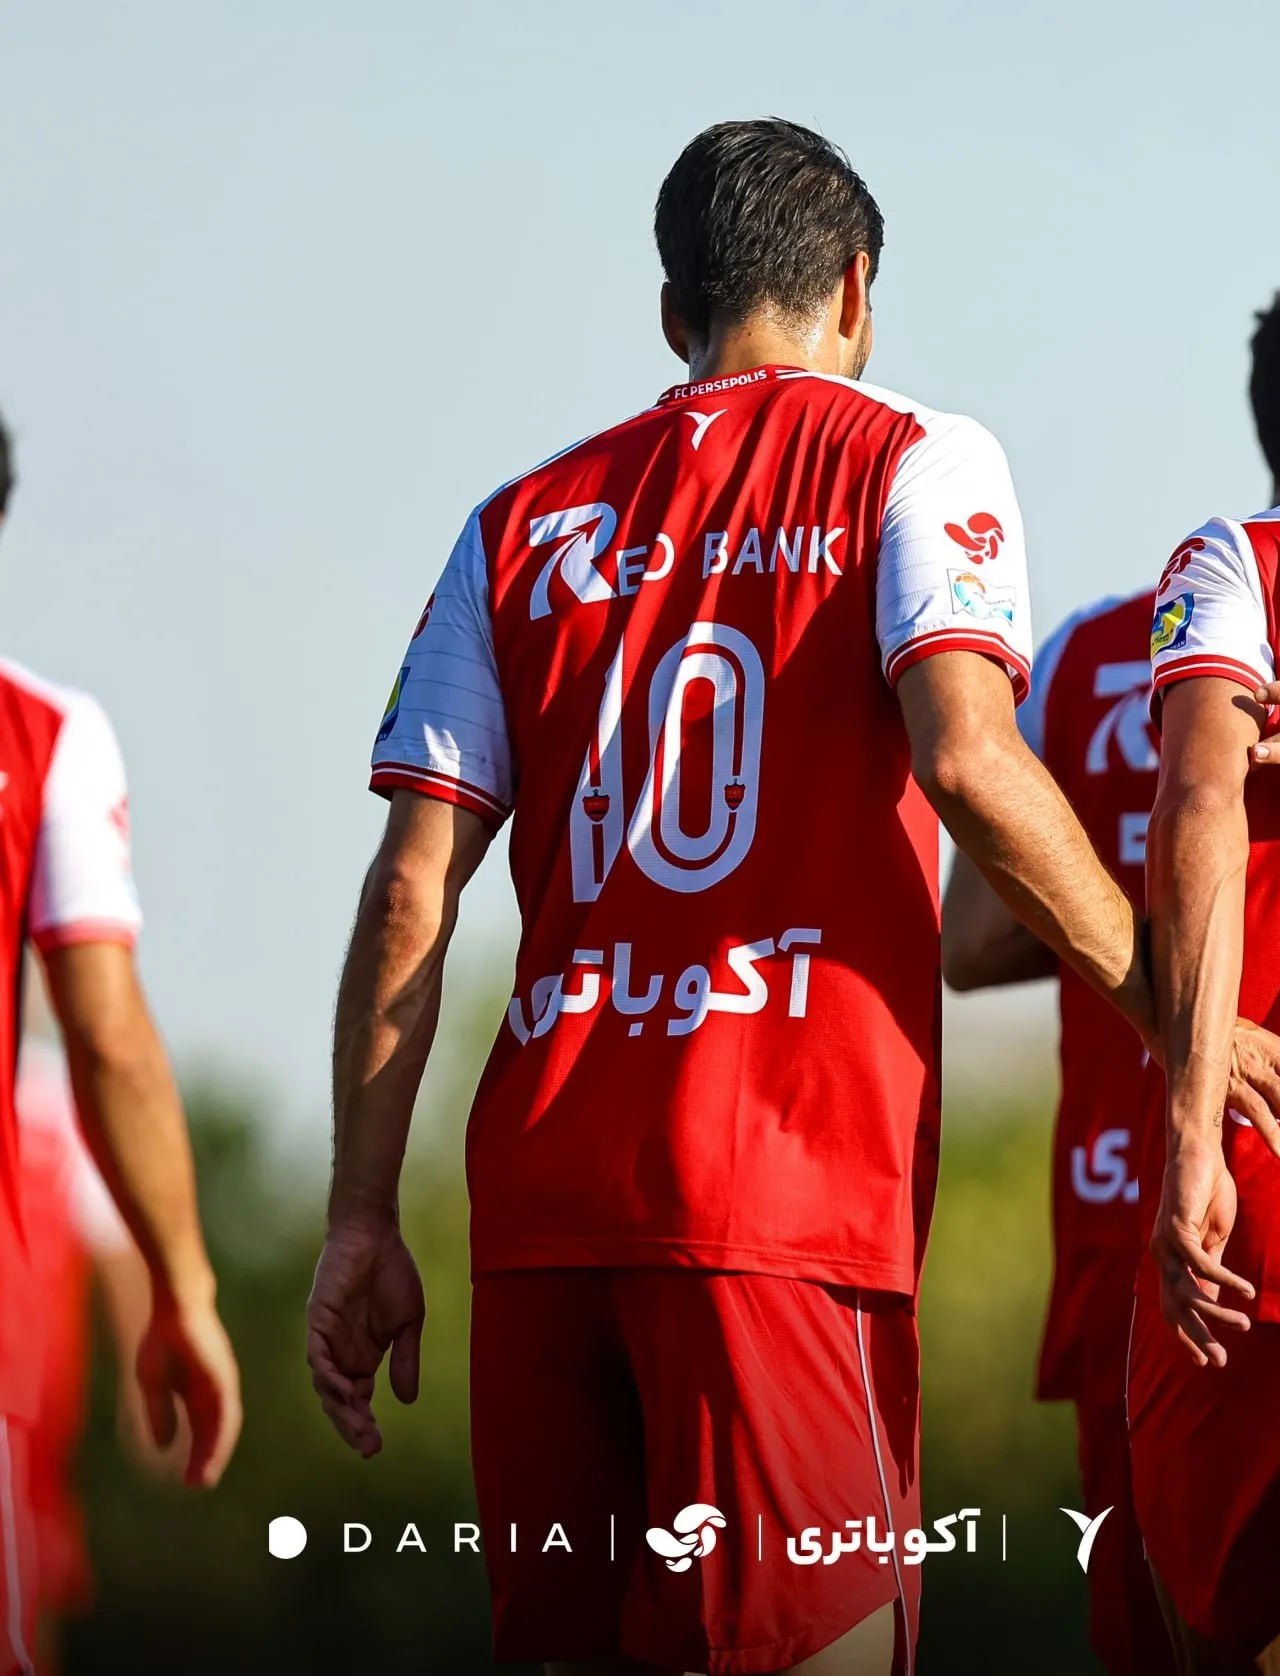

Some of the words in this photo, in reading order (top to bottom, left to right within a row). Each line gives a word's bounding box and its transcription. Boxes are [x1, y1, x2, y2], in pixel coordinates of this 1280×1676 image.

[675, 387, 688, 399] FC
[690, 369, 767, 396] PERSEPOLIS
[702, 526, 846, 579] BANK
[570, 622, 764, 902] 10
